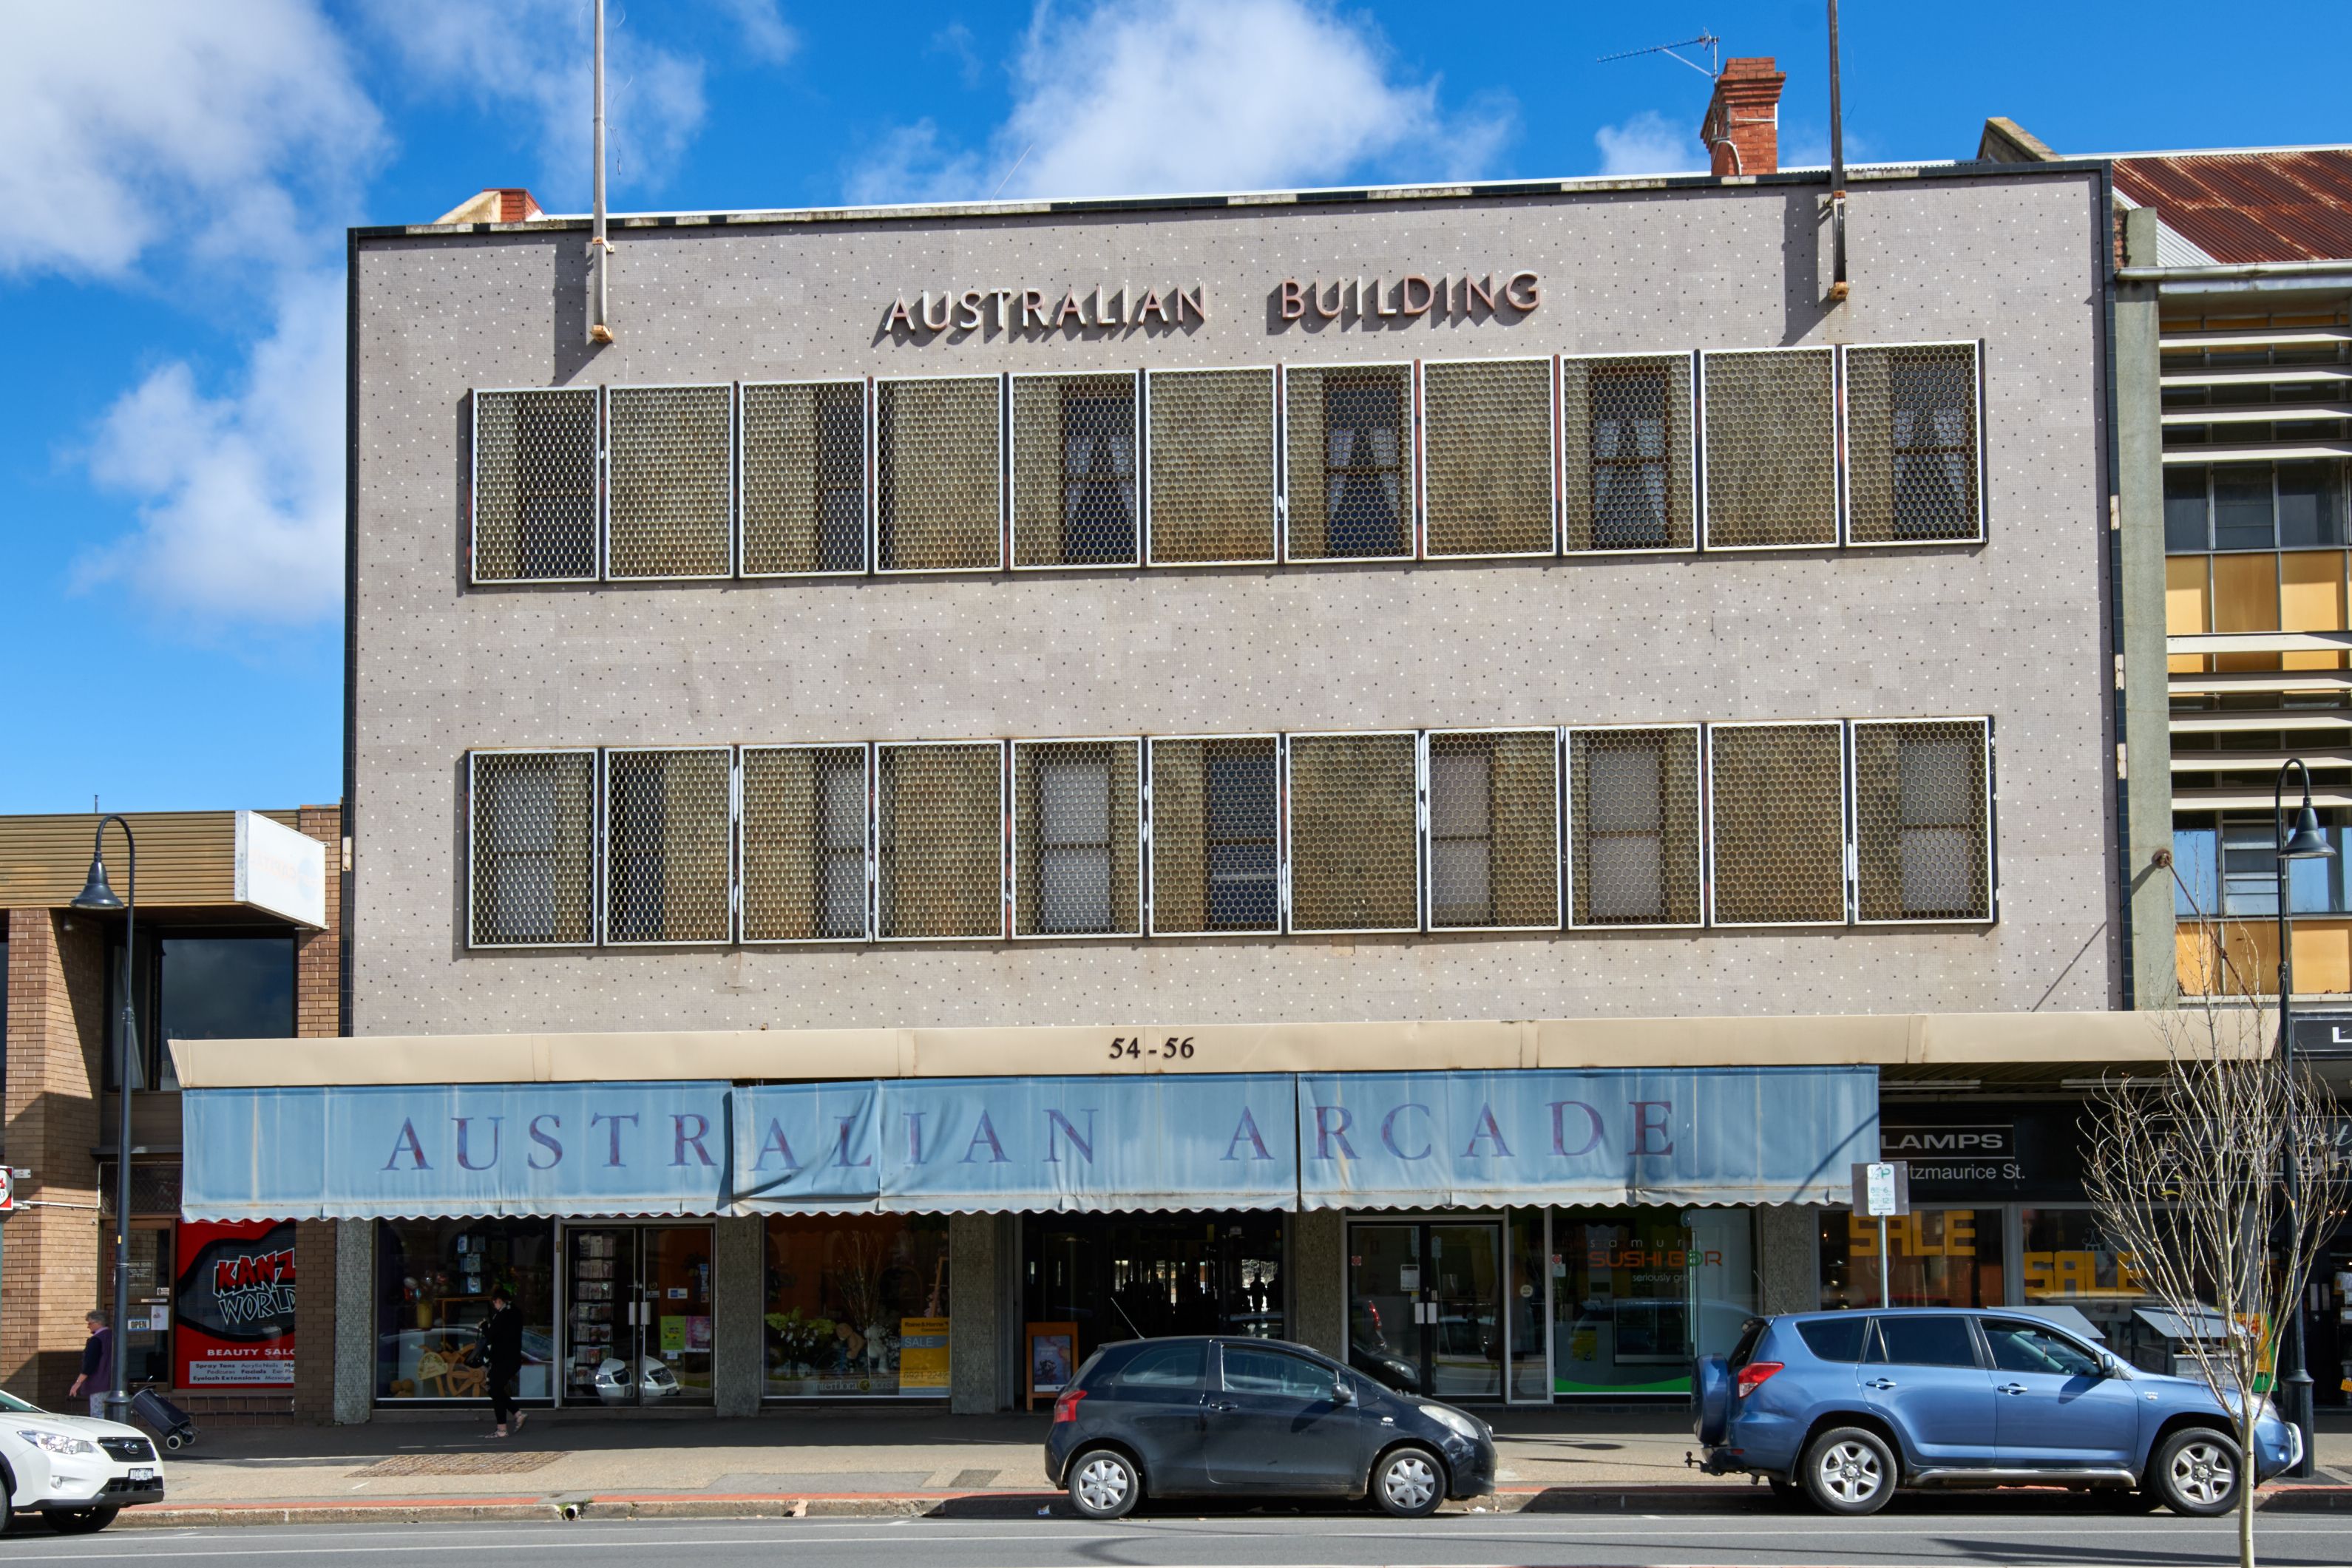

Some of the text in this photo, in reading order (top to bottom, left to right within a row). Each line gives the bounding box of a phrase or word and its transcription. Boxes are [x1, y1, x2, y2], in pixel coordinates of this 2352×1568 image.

[885, 270, 1542, 332] AUSTRALIAN BUILDING
[381, 1101, 1675, 1172] AUSTRALIAN ARCADE
[1880, 1133, 2004, 1150] LAMPS
[1909, 1163, 2026, 1183] tzmaurice St.
[1849, 1209, 1976, 1256] SALE
[1587, 1249, 1661, 1267] SUSHI
[1632, 1272, 1671, 1284] seriously
[2024, 1251, 2143, 1298] SALE
[130, 1320, 147, 1329] OPEN
[904, 1337, 934, 1348] SALE
